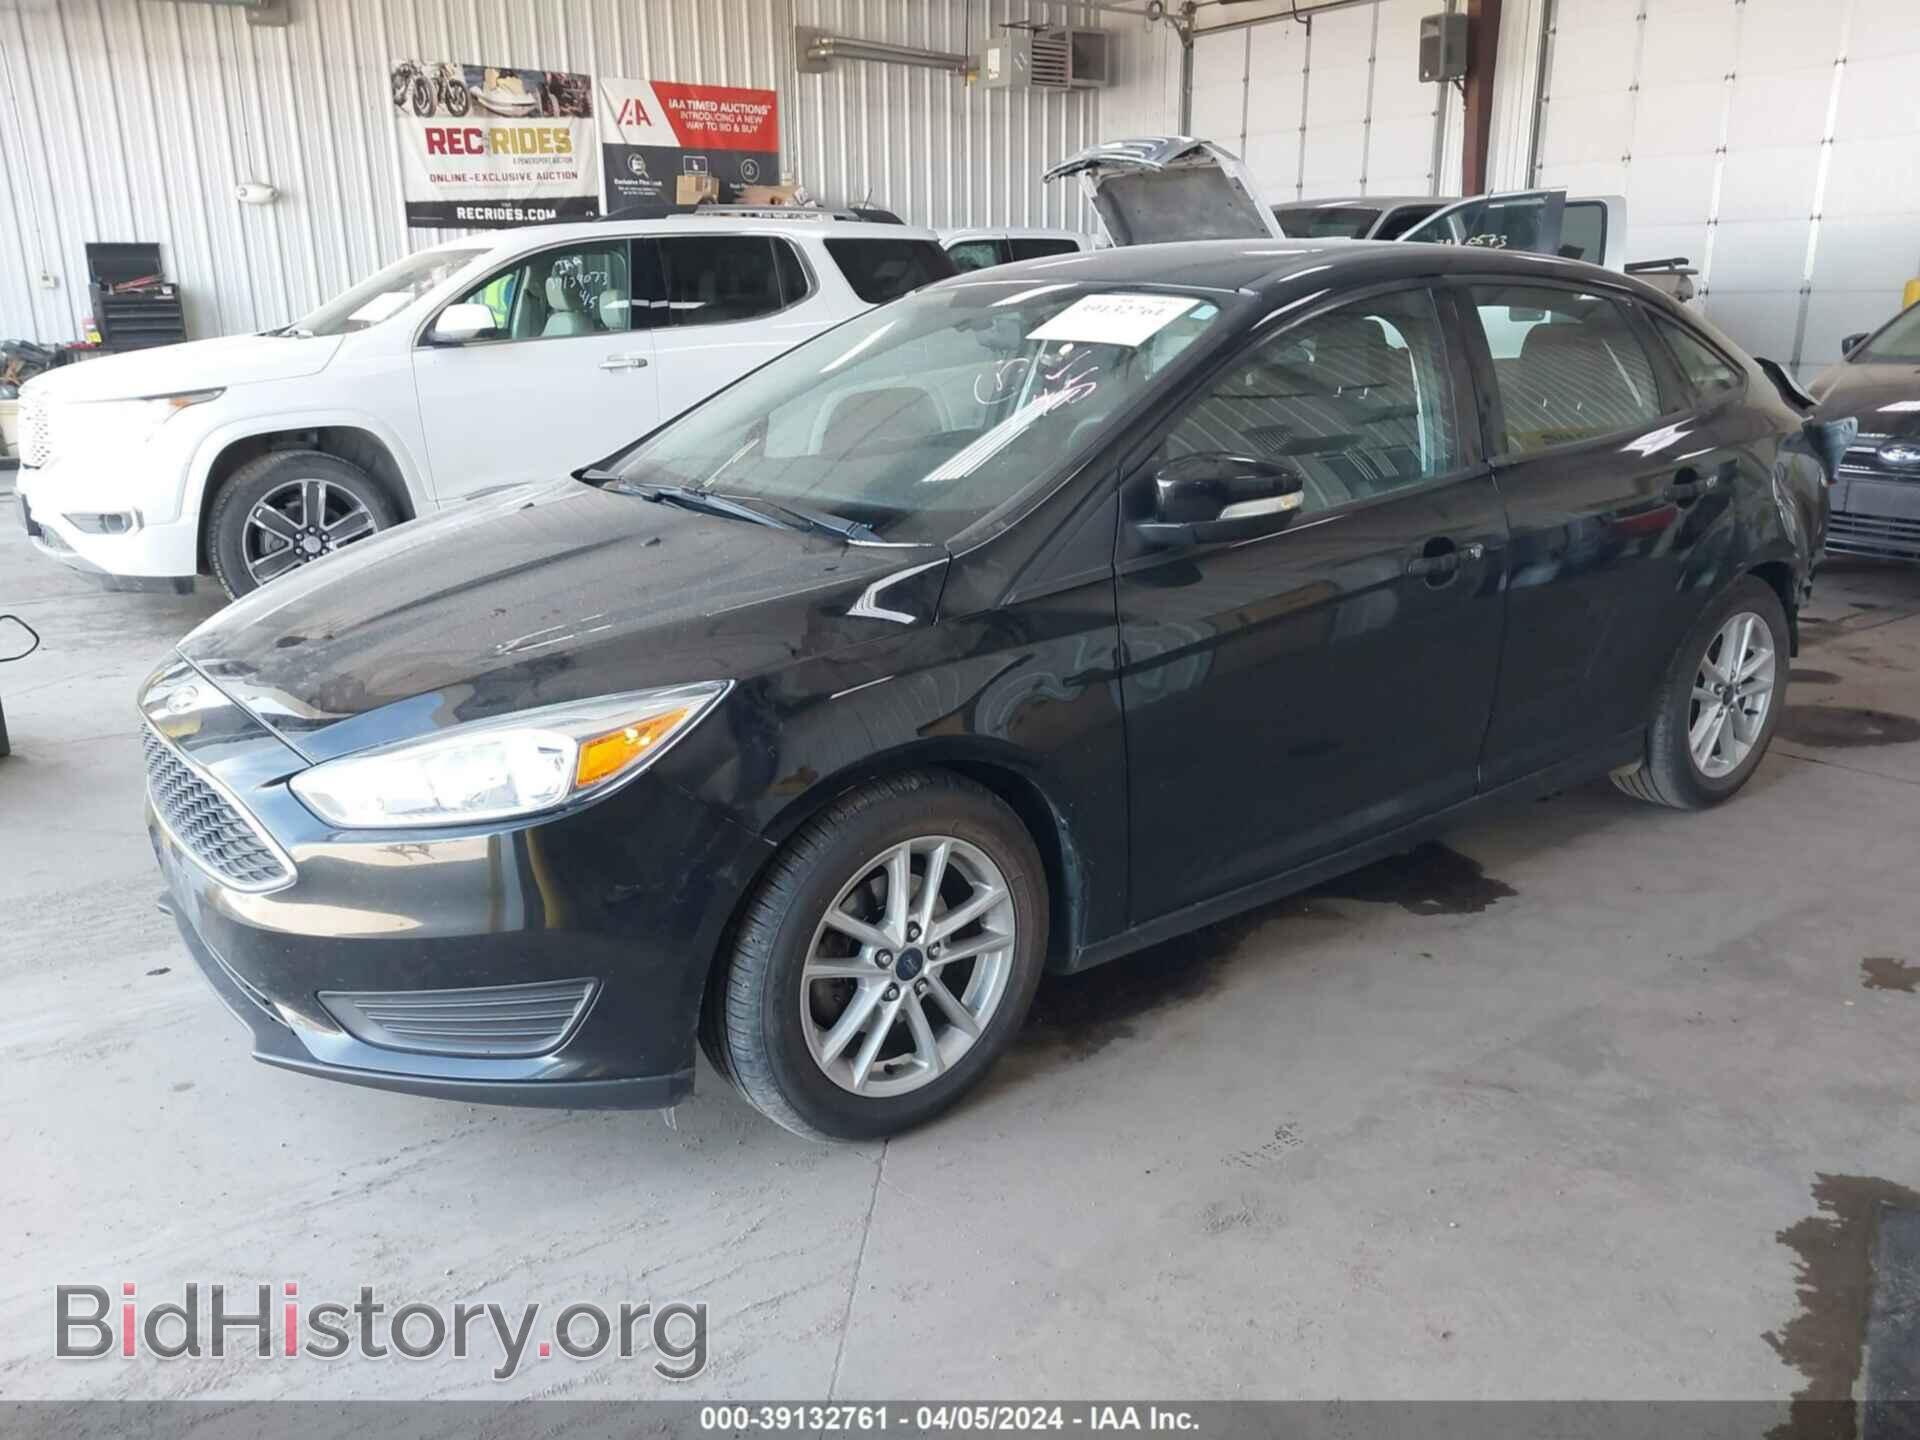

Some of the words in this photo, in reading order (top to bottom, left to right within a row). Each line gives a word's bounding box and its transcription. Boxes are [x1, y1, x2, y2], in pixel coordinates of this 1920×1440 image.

[668, 98, 686, 109] IAA
[687, 100, 718, 111] TIMED
[680, 110, 735, 122] INTRODUCING
[736, 113, 743, 122] A
[744, 114, 764, 124] NEW
[685, 121, 705, 130] WAY
[706, 122, 718, 131] TO
[425, 127, 485, 155] REC
[489, 127, 573, 155] RIDES
[430, 172, 533, 183] ONLINE-EXCLUSIVE
[536, 171, 578, 181] AUCTION
[456, 207, 557, 221] RECRIDES.COM
